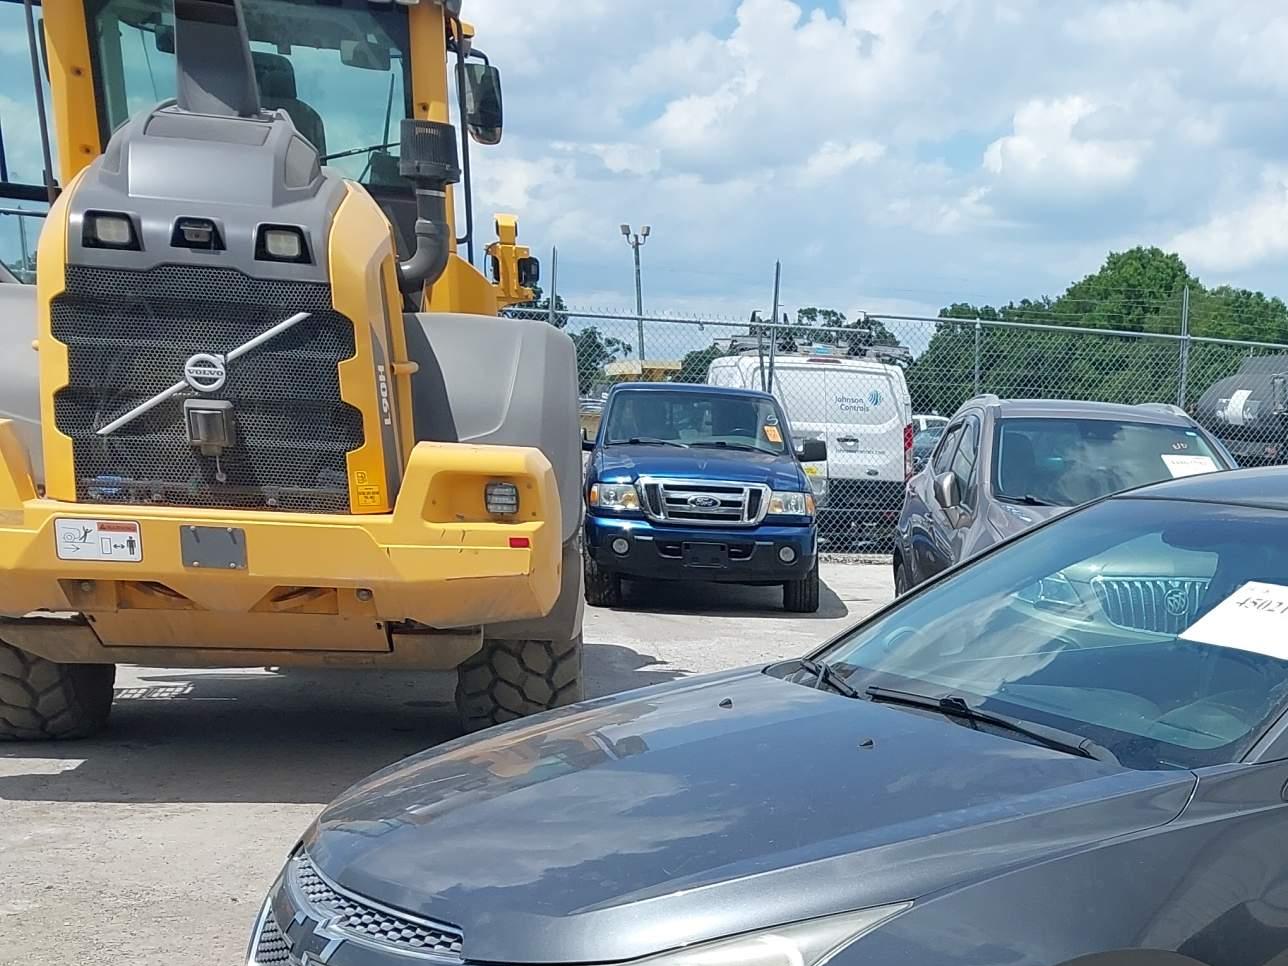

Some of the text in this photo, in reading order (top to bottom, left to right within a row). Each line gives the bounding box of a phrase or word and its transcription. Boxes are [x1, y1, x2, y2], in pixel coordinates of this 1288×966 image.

[188, 369, 224, 377] VOLVO
[377, 365, 391, 425] L90H
[835, 394, 864, 404] Johnson
[840, 404, 869, 413] Controls
